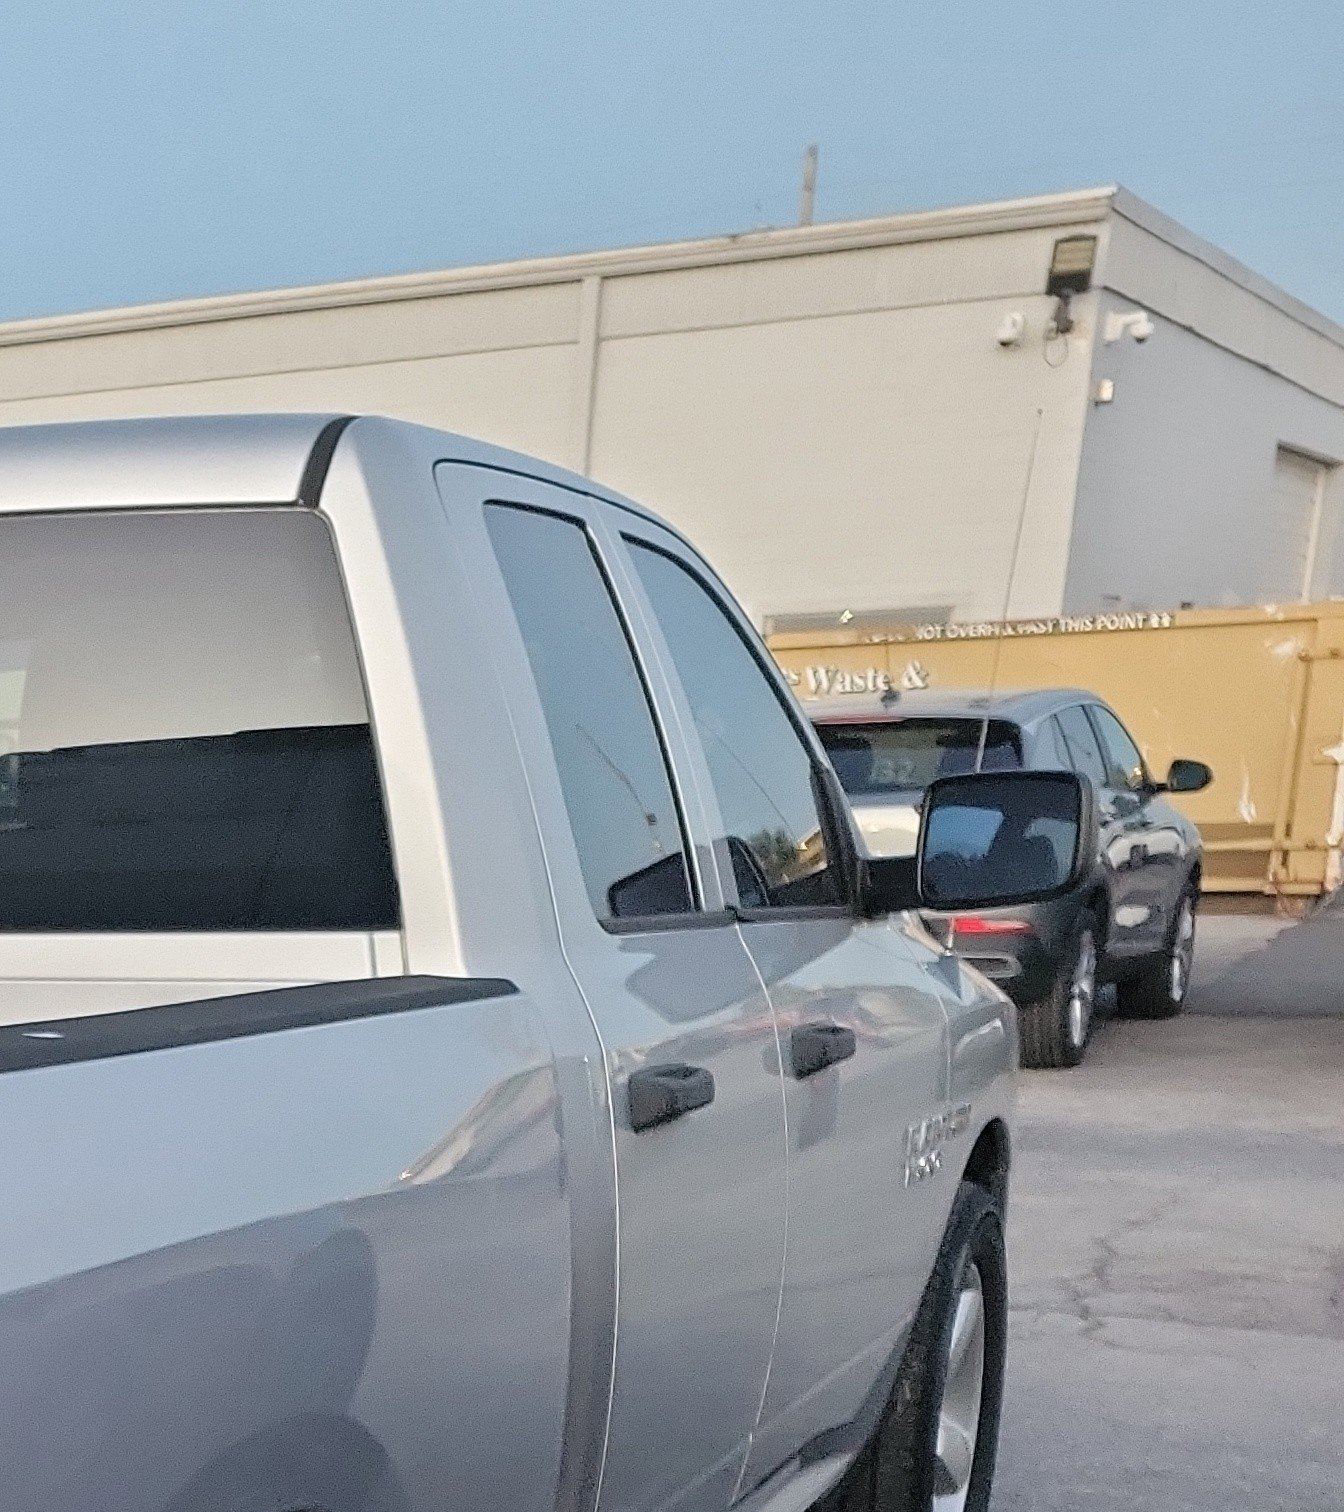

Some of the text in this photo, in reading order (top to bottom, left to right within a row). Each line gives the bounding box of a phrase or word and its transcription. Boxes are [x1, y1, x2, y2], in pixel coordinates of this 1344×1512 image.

[1060, 615, 1095, 633] THIS
[1095, 612, 1149, 631] POINT
[806, 664, 891, 694] Waste
[901, 659, 930, 690] &
